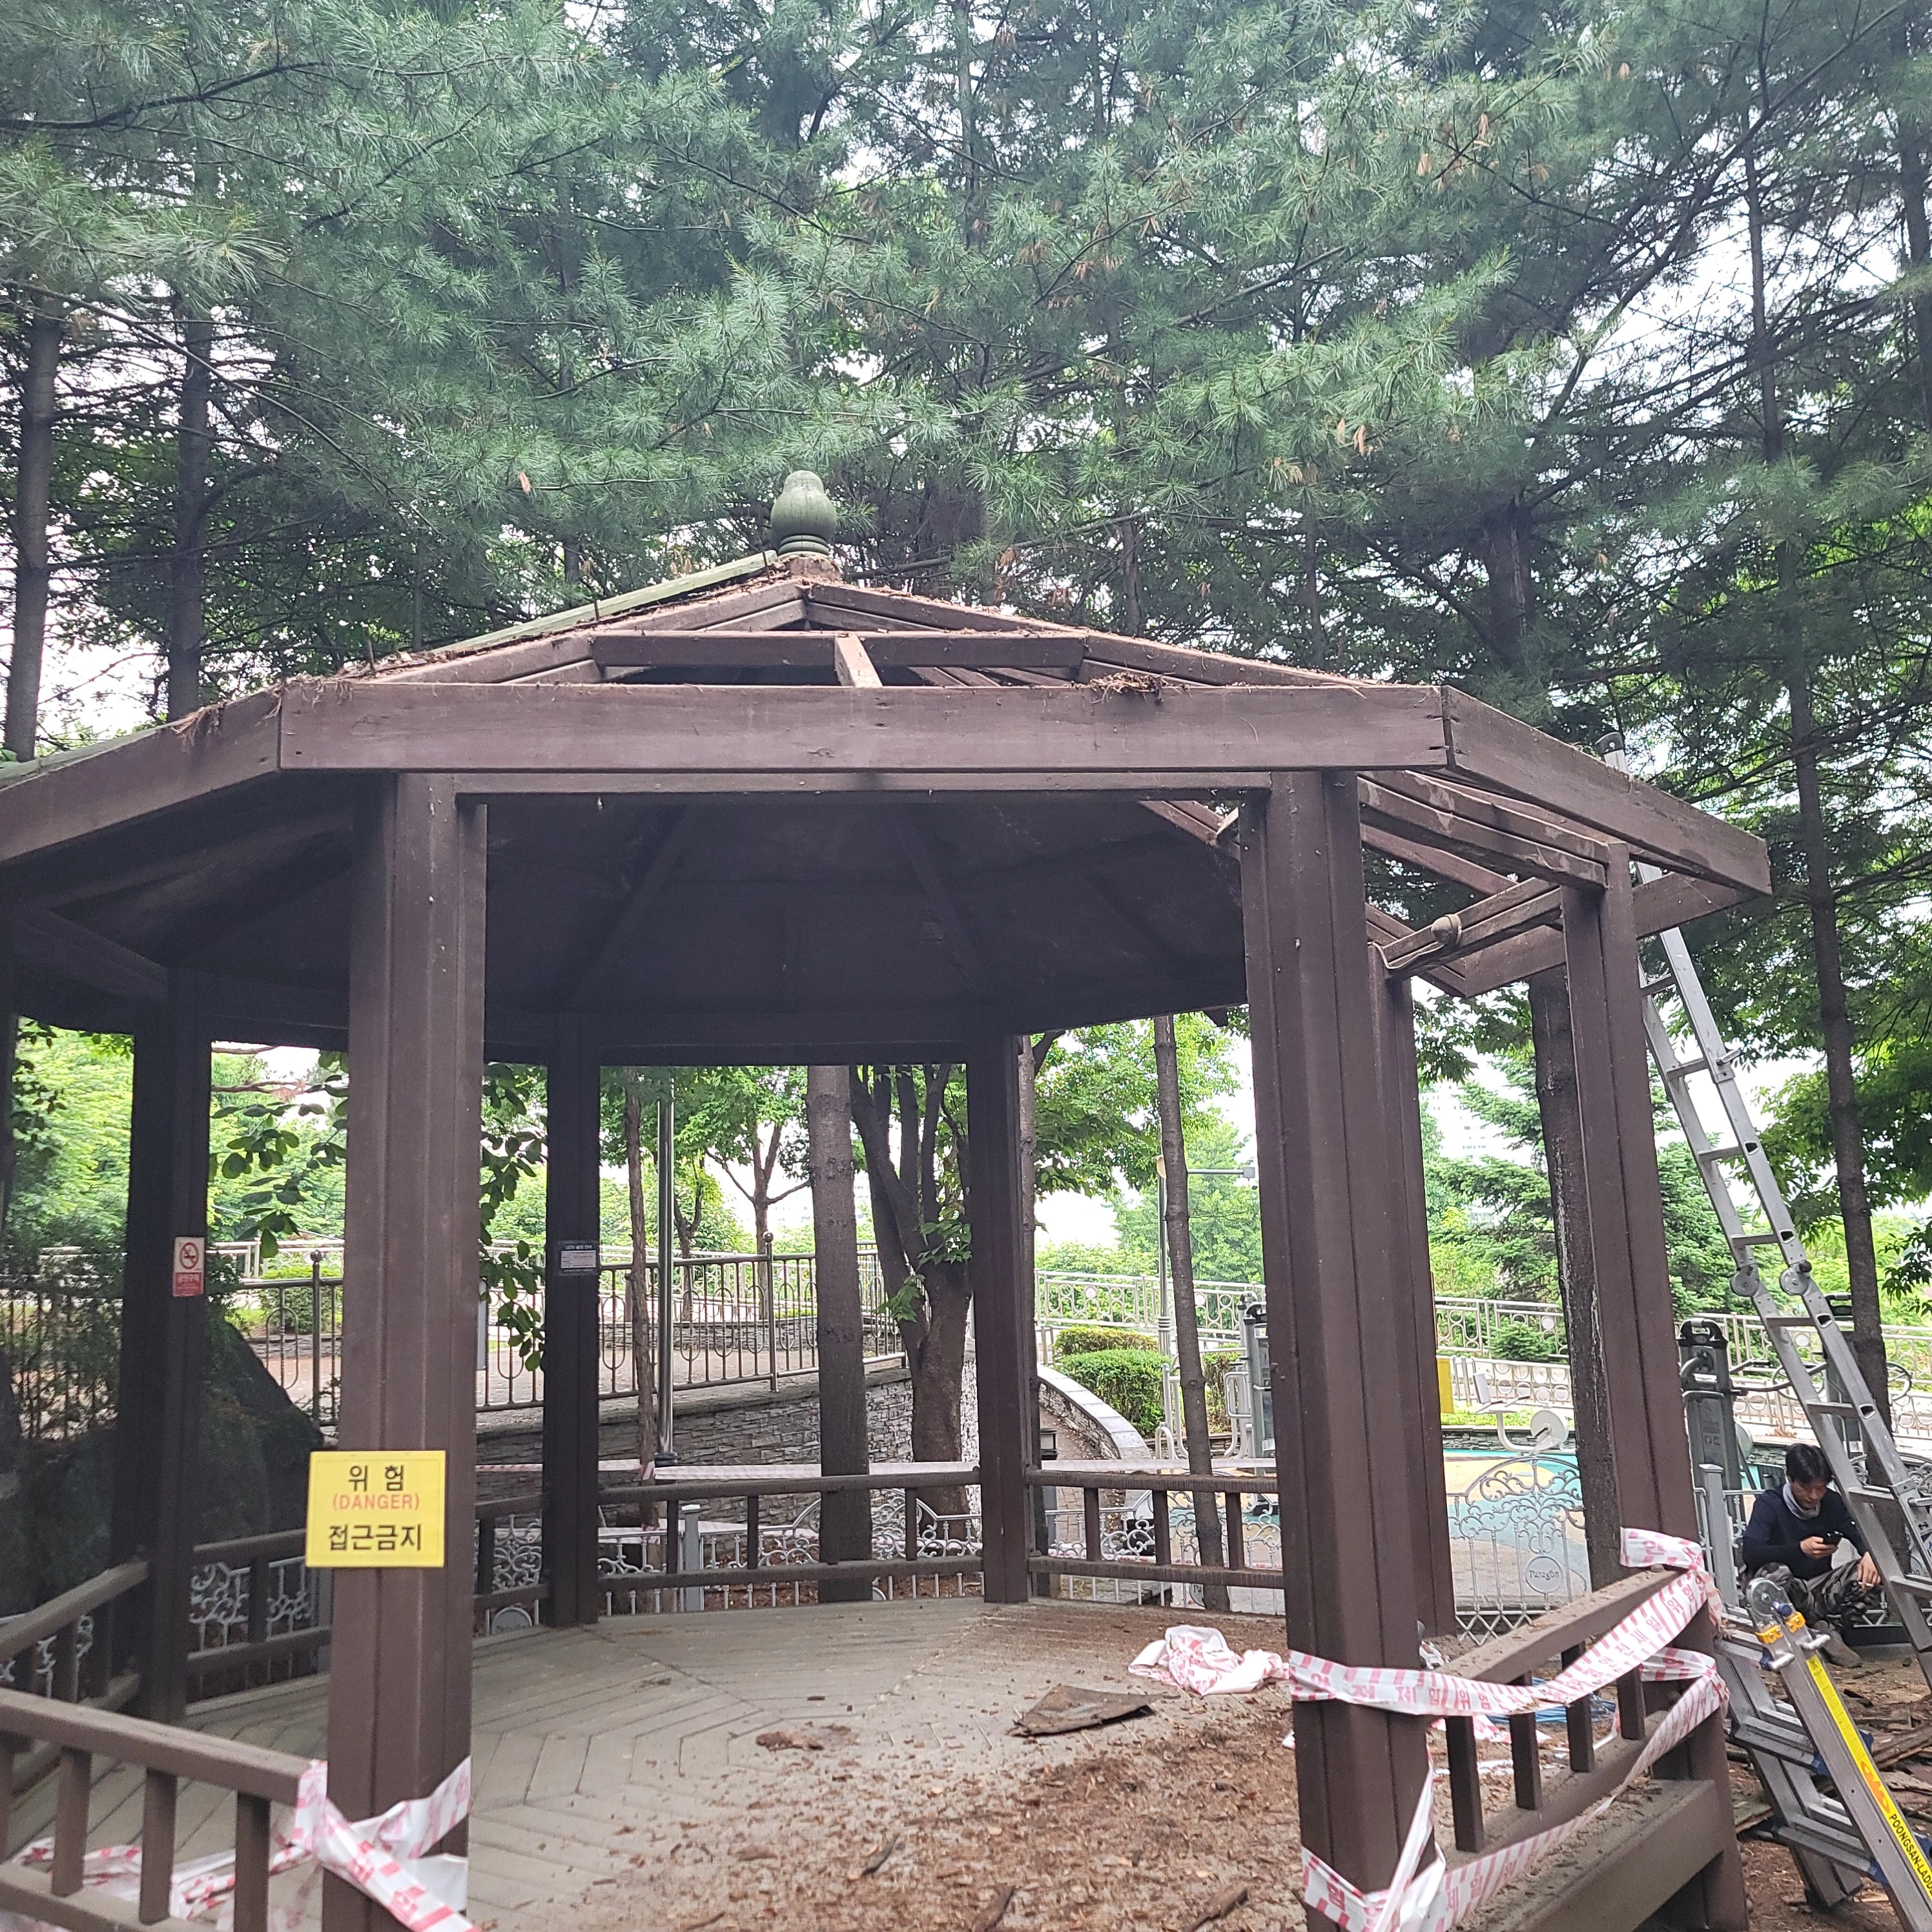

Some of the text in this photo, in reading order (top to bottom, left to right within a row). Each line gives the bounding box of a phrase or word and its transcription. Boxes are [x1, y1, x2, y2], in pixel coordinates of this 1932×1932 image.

[333, 1493, 420, 1510] (DANGER)
[329, 1524, 422, 1551] 접근금지
[1529, 1570, 1559, 1581] Paragon
